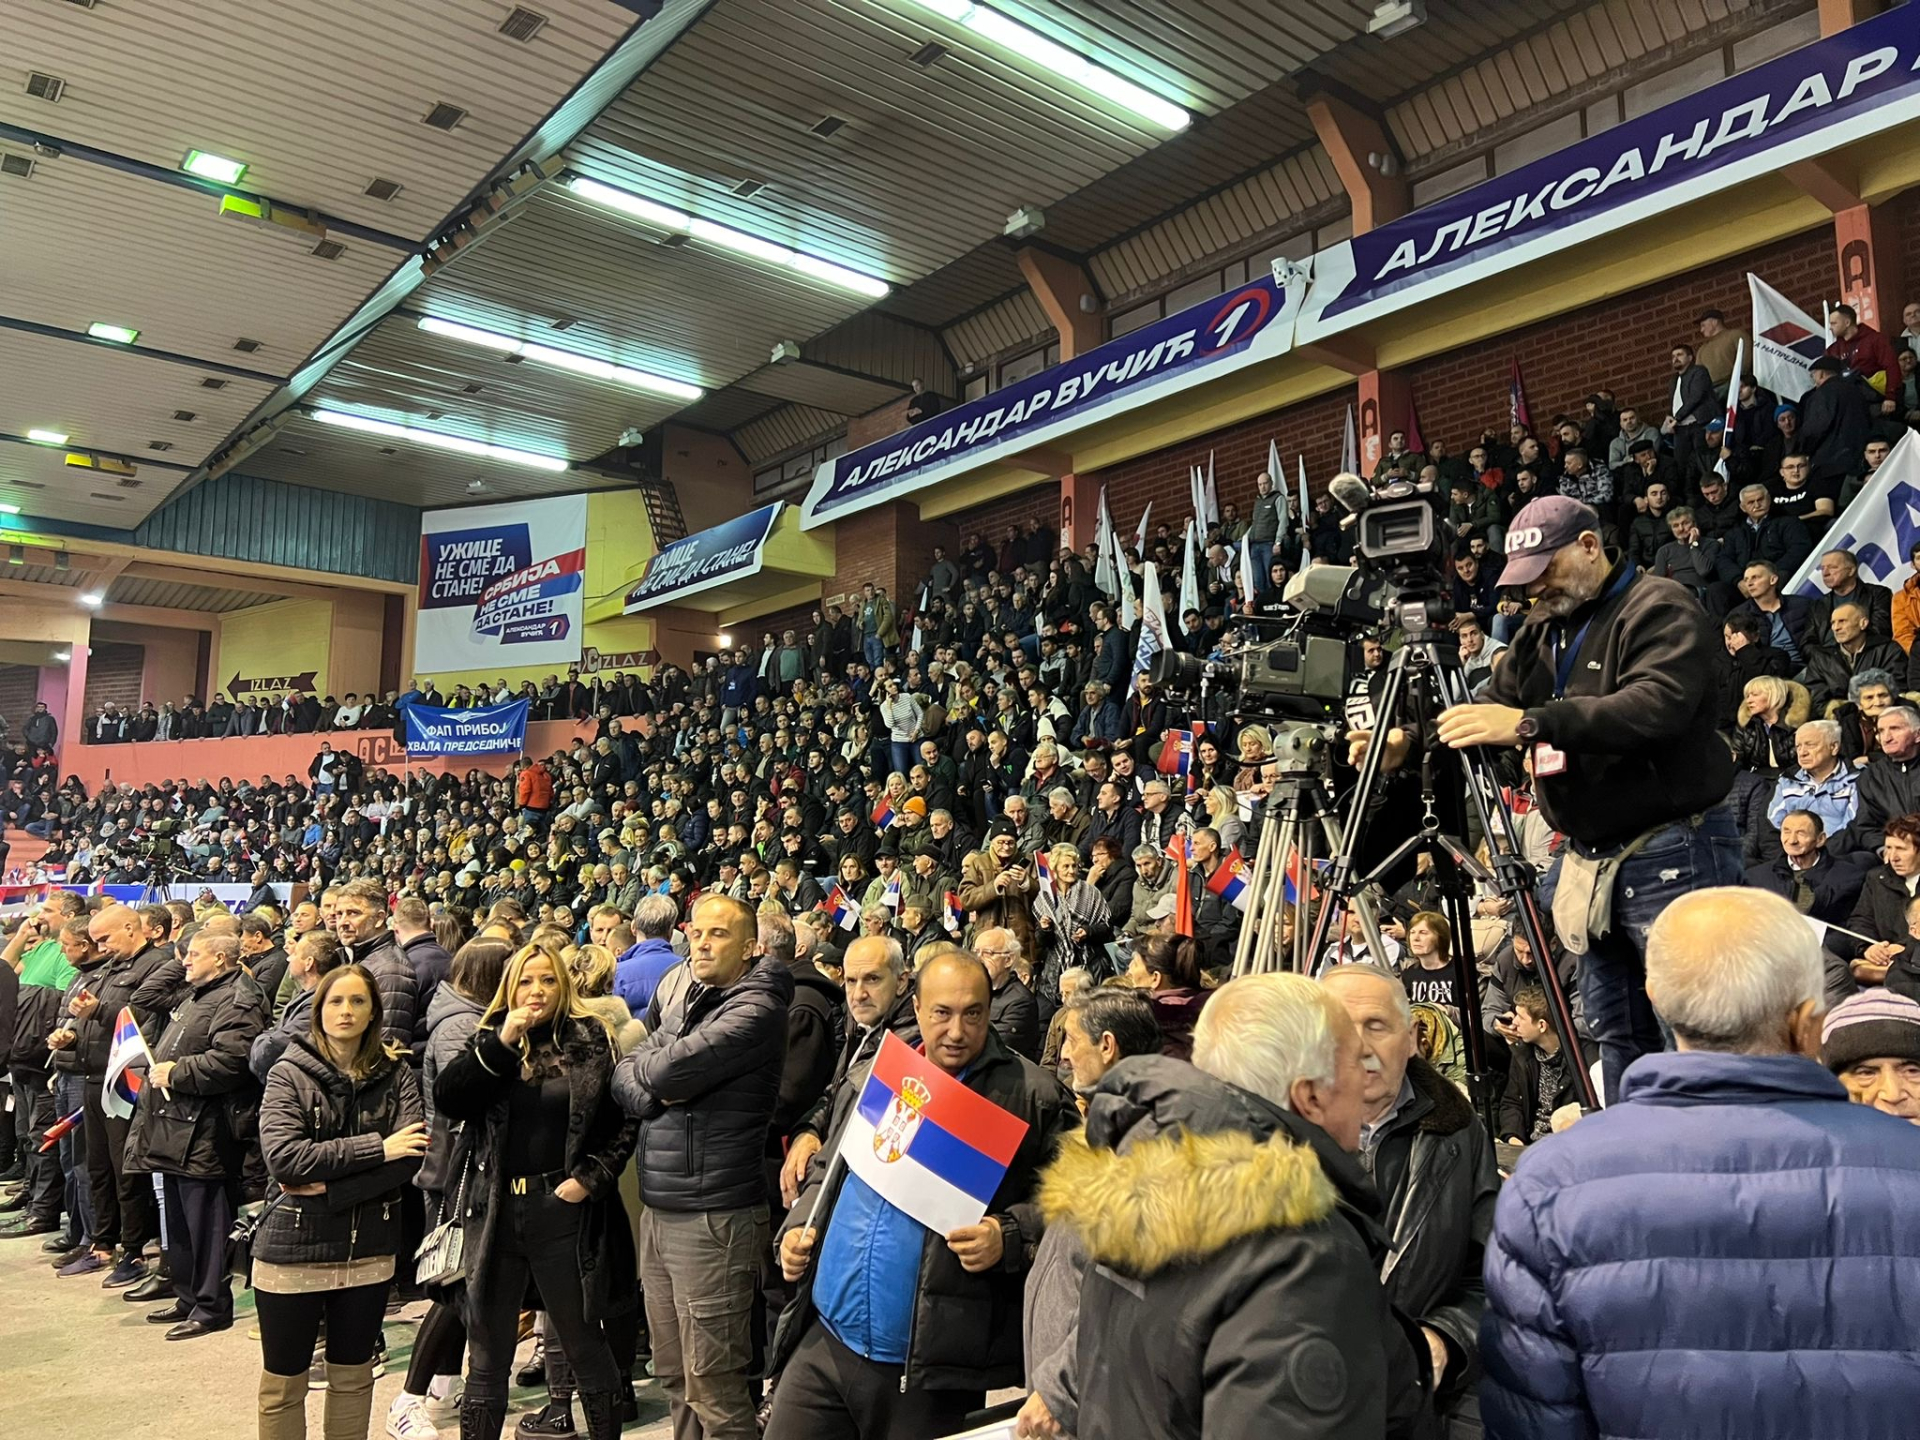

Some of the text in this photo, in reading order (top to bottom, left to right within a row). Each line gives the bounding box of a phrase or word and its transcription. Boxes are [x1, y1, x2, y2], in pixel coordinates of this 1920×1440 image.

[1374, 46, 1898, 280] АЛЕКСАНДАР
[839, 389, 1053, 492] АЛЕКСАНДАР
[1050, 329, 1196, 411] ВУЧИЋ
[439, 538, 503, 562] УЖИЦЕ
[435, 555, 515, 580] НЕ СМЕ ДА
[484, 559, 560, 600] СРБИЈА
[432, 577, 484, 599] СТАНЕ!
[480, 584, 541, 616] НЕ СМЕ
[476, 600, 554, 631] ДА СТАНЕ!
[250, 677, 291, 691] IZLAZ
[426, 723, 506, 737] ФАП ПРИБОЈ
[407, 740, 440, 752] ХВАЛА
[1412, 981, 1452, 1003] ICON
